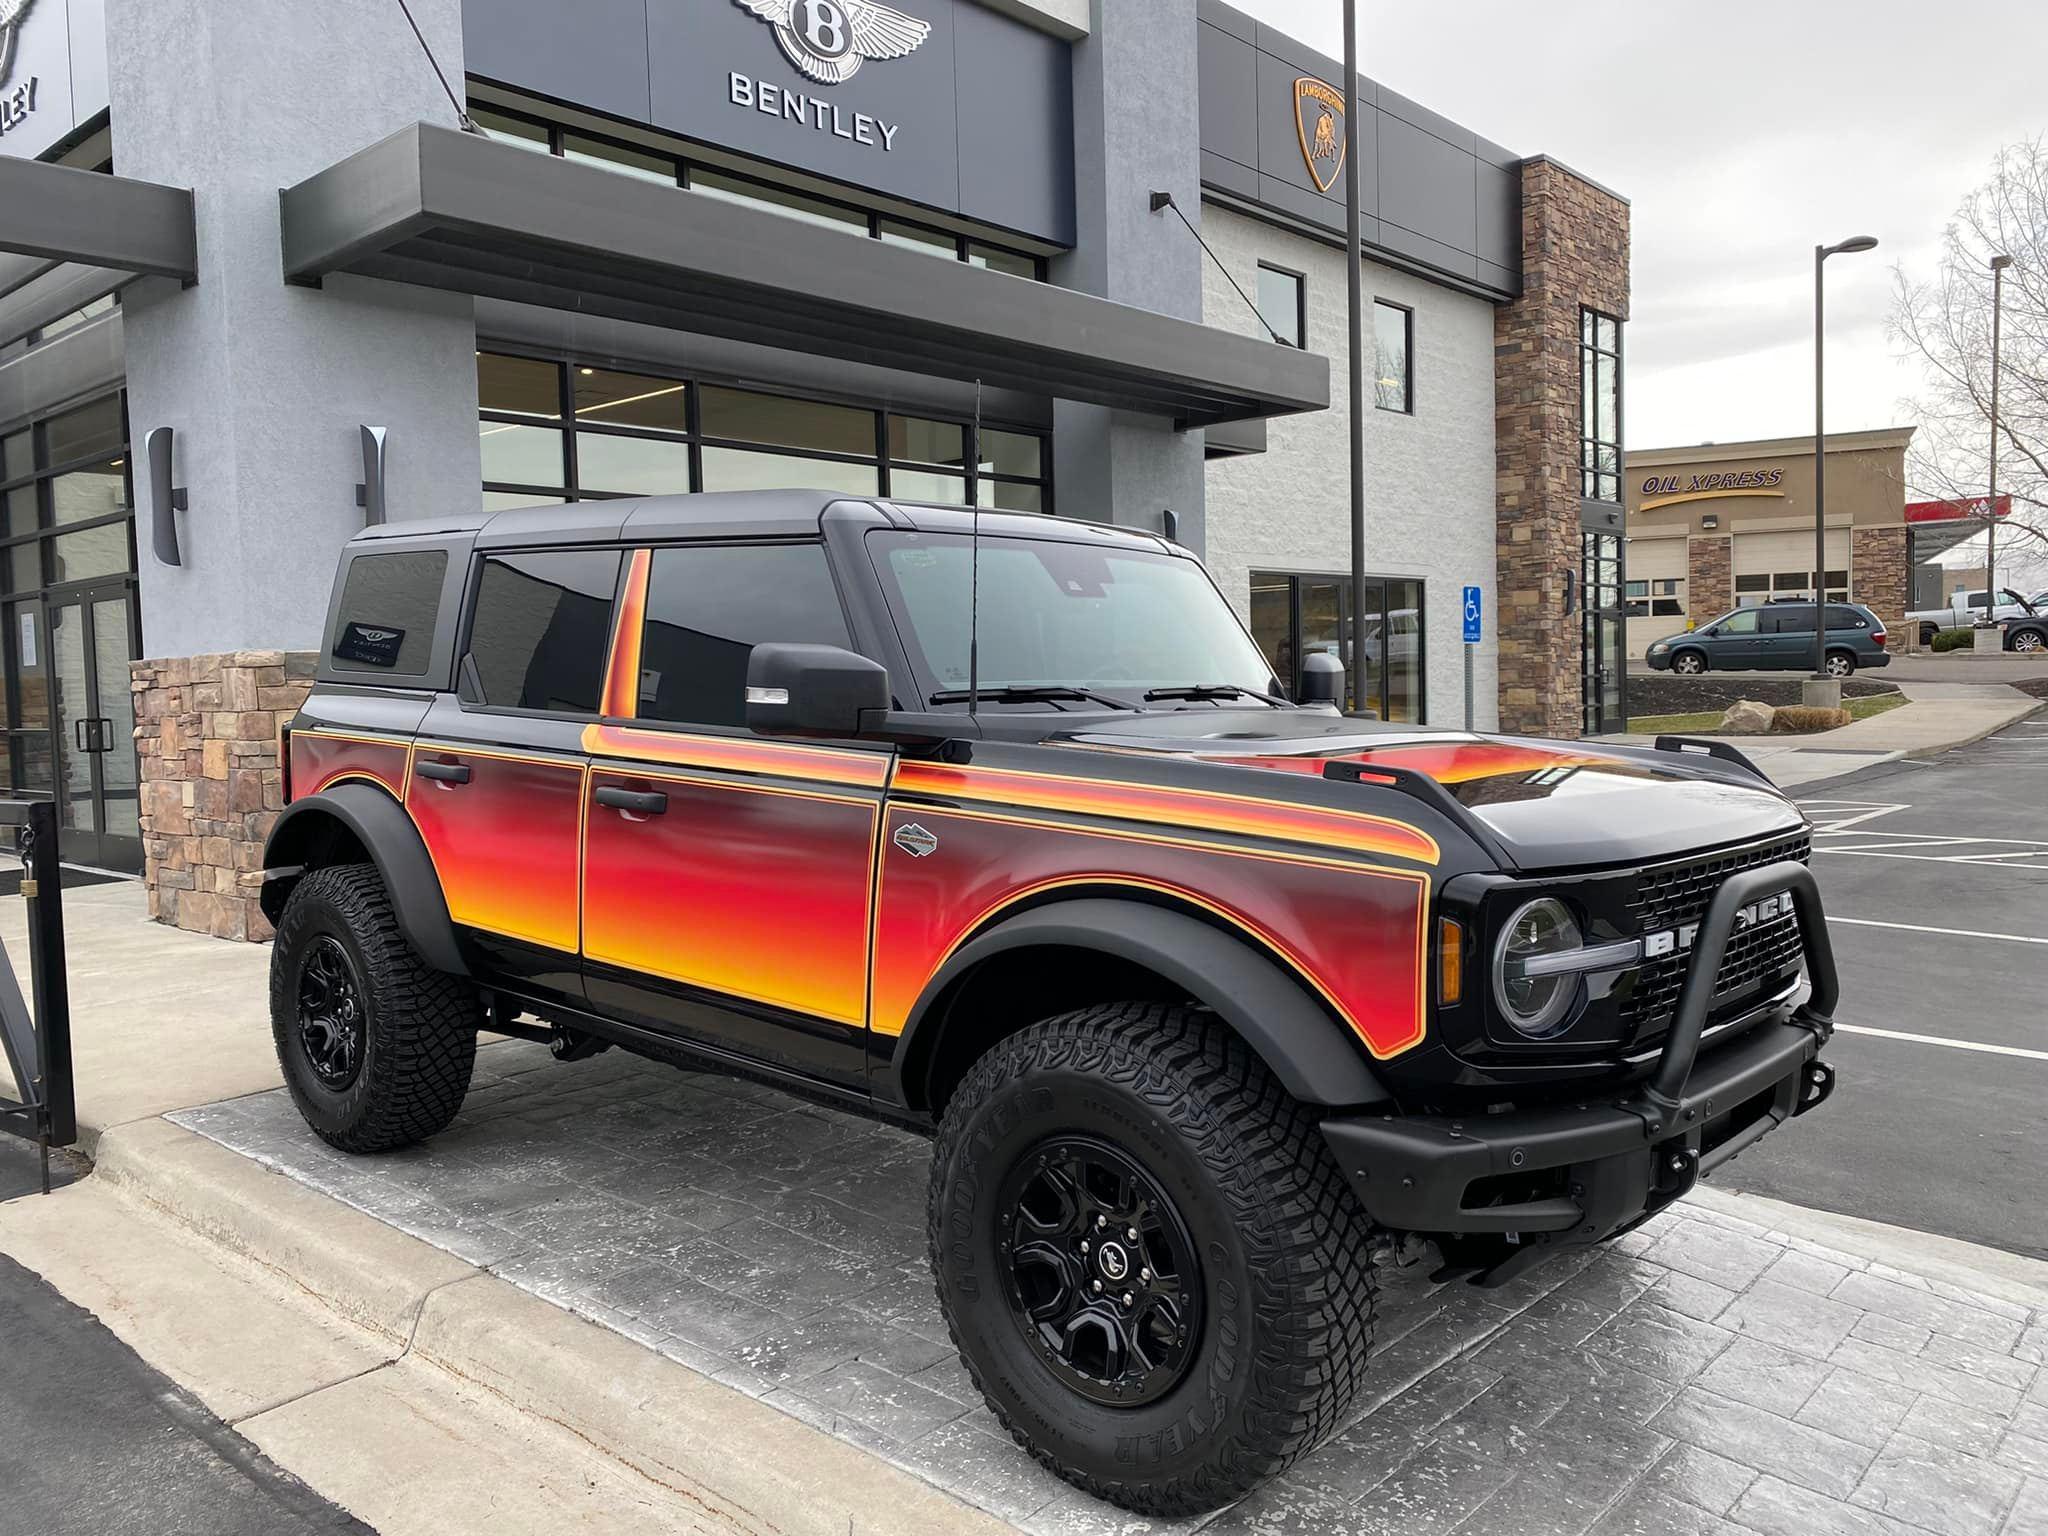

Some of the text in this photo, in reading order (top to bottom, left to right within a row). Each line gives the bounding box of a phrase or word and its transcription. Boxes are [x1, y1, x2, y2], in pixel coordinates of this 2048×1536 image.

[0, 75, 38, 136] LEY
[729, 71, 898, 151] BENTLEY
[1641, 467, 1785, 495] OIL XPRESS
[1645, 890, 1795, 957] BRNCO
